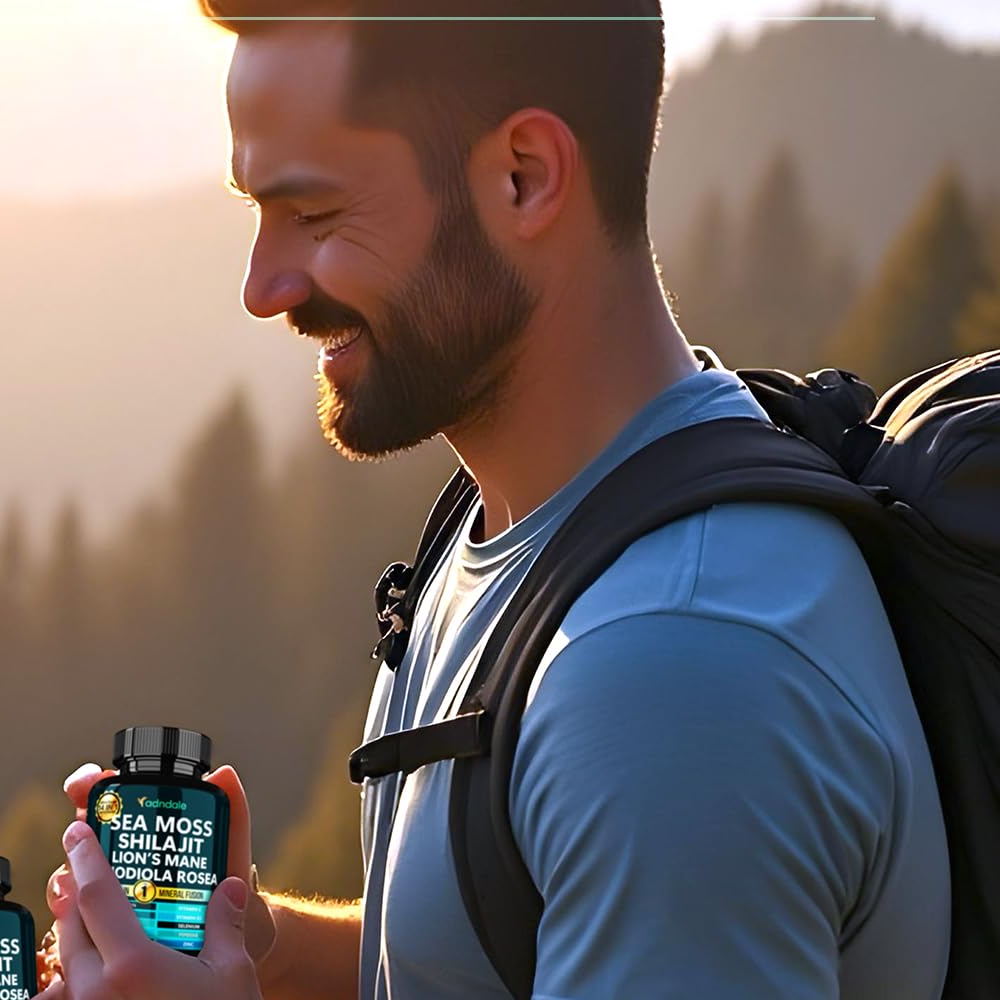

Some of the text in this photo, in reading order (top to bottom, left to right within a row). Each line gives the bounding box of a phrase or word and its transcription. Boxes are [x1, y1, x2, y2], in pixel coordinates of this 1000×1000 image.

[110, 814, 213, 836] SEA MOSS
[118, 833, 205, 854] SHILAJIT
[112, 850, 208, 870] LION'S MANE
[112, 866, 218, 886] ODIOLA ROSEA
[159, 889, 184, 899] MINERAL
